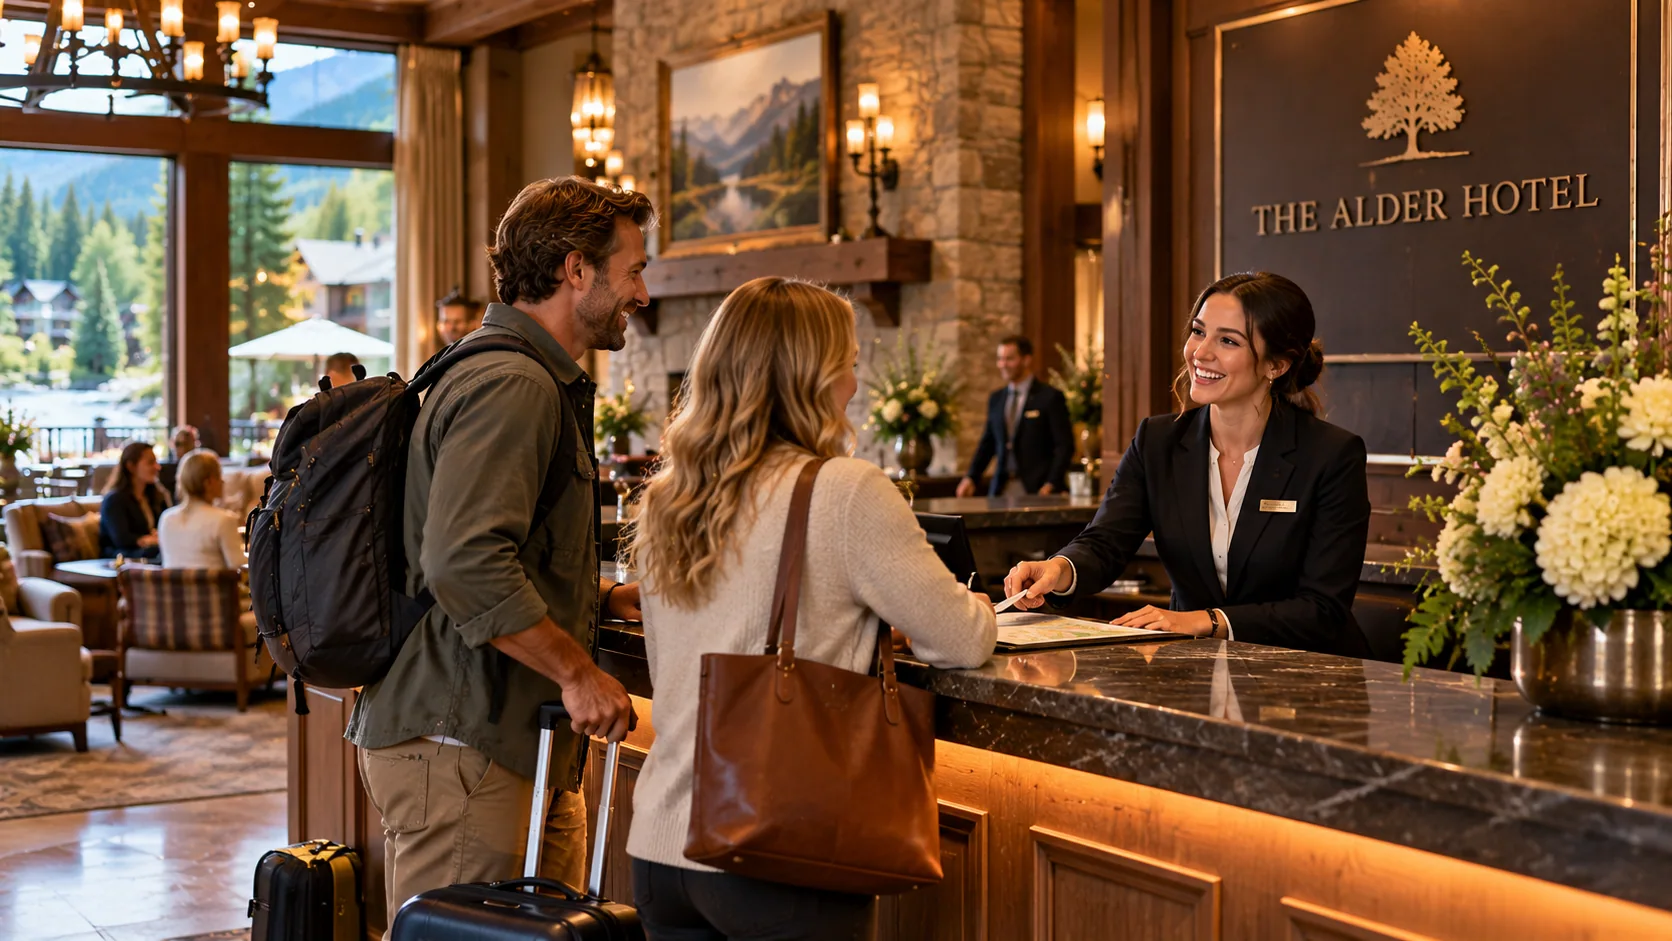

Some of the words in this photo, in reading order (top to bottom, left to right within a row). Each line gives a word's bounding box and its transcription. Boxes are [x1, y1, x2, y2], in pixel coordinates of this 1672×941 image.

[1252, 201, 1317, 235] THE
[1330, 188, 1448, 229] ALDER
[1462, 173, 1599, 218] HOTEL
